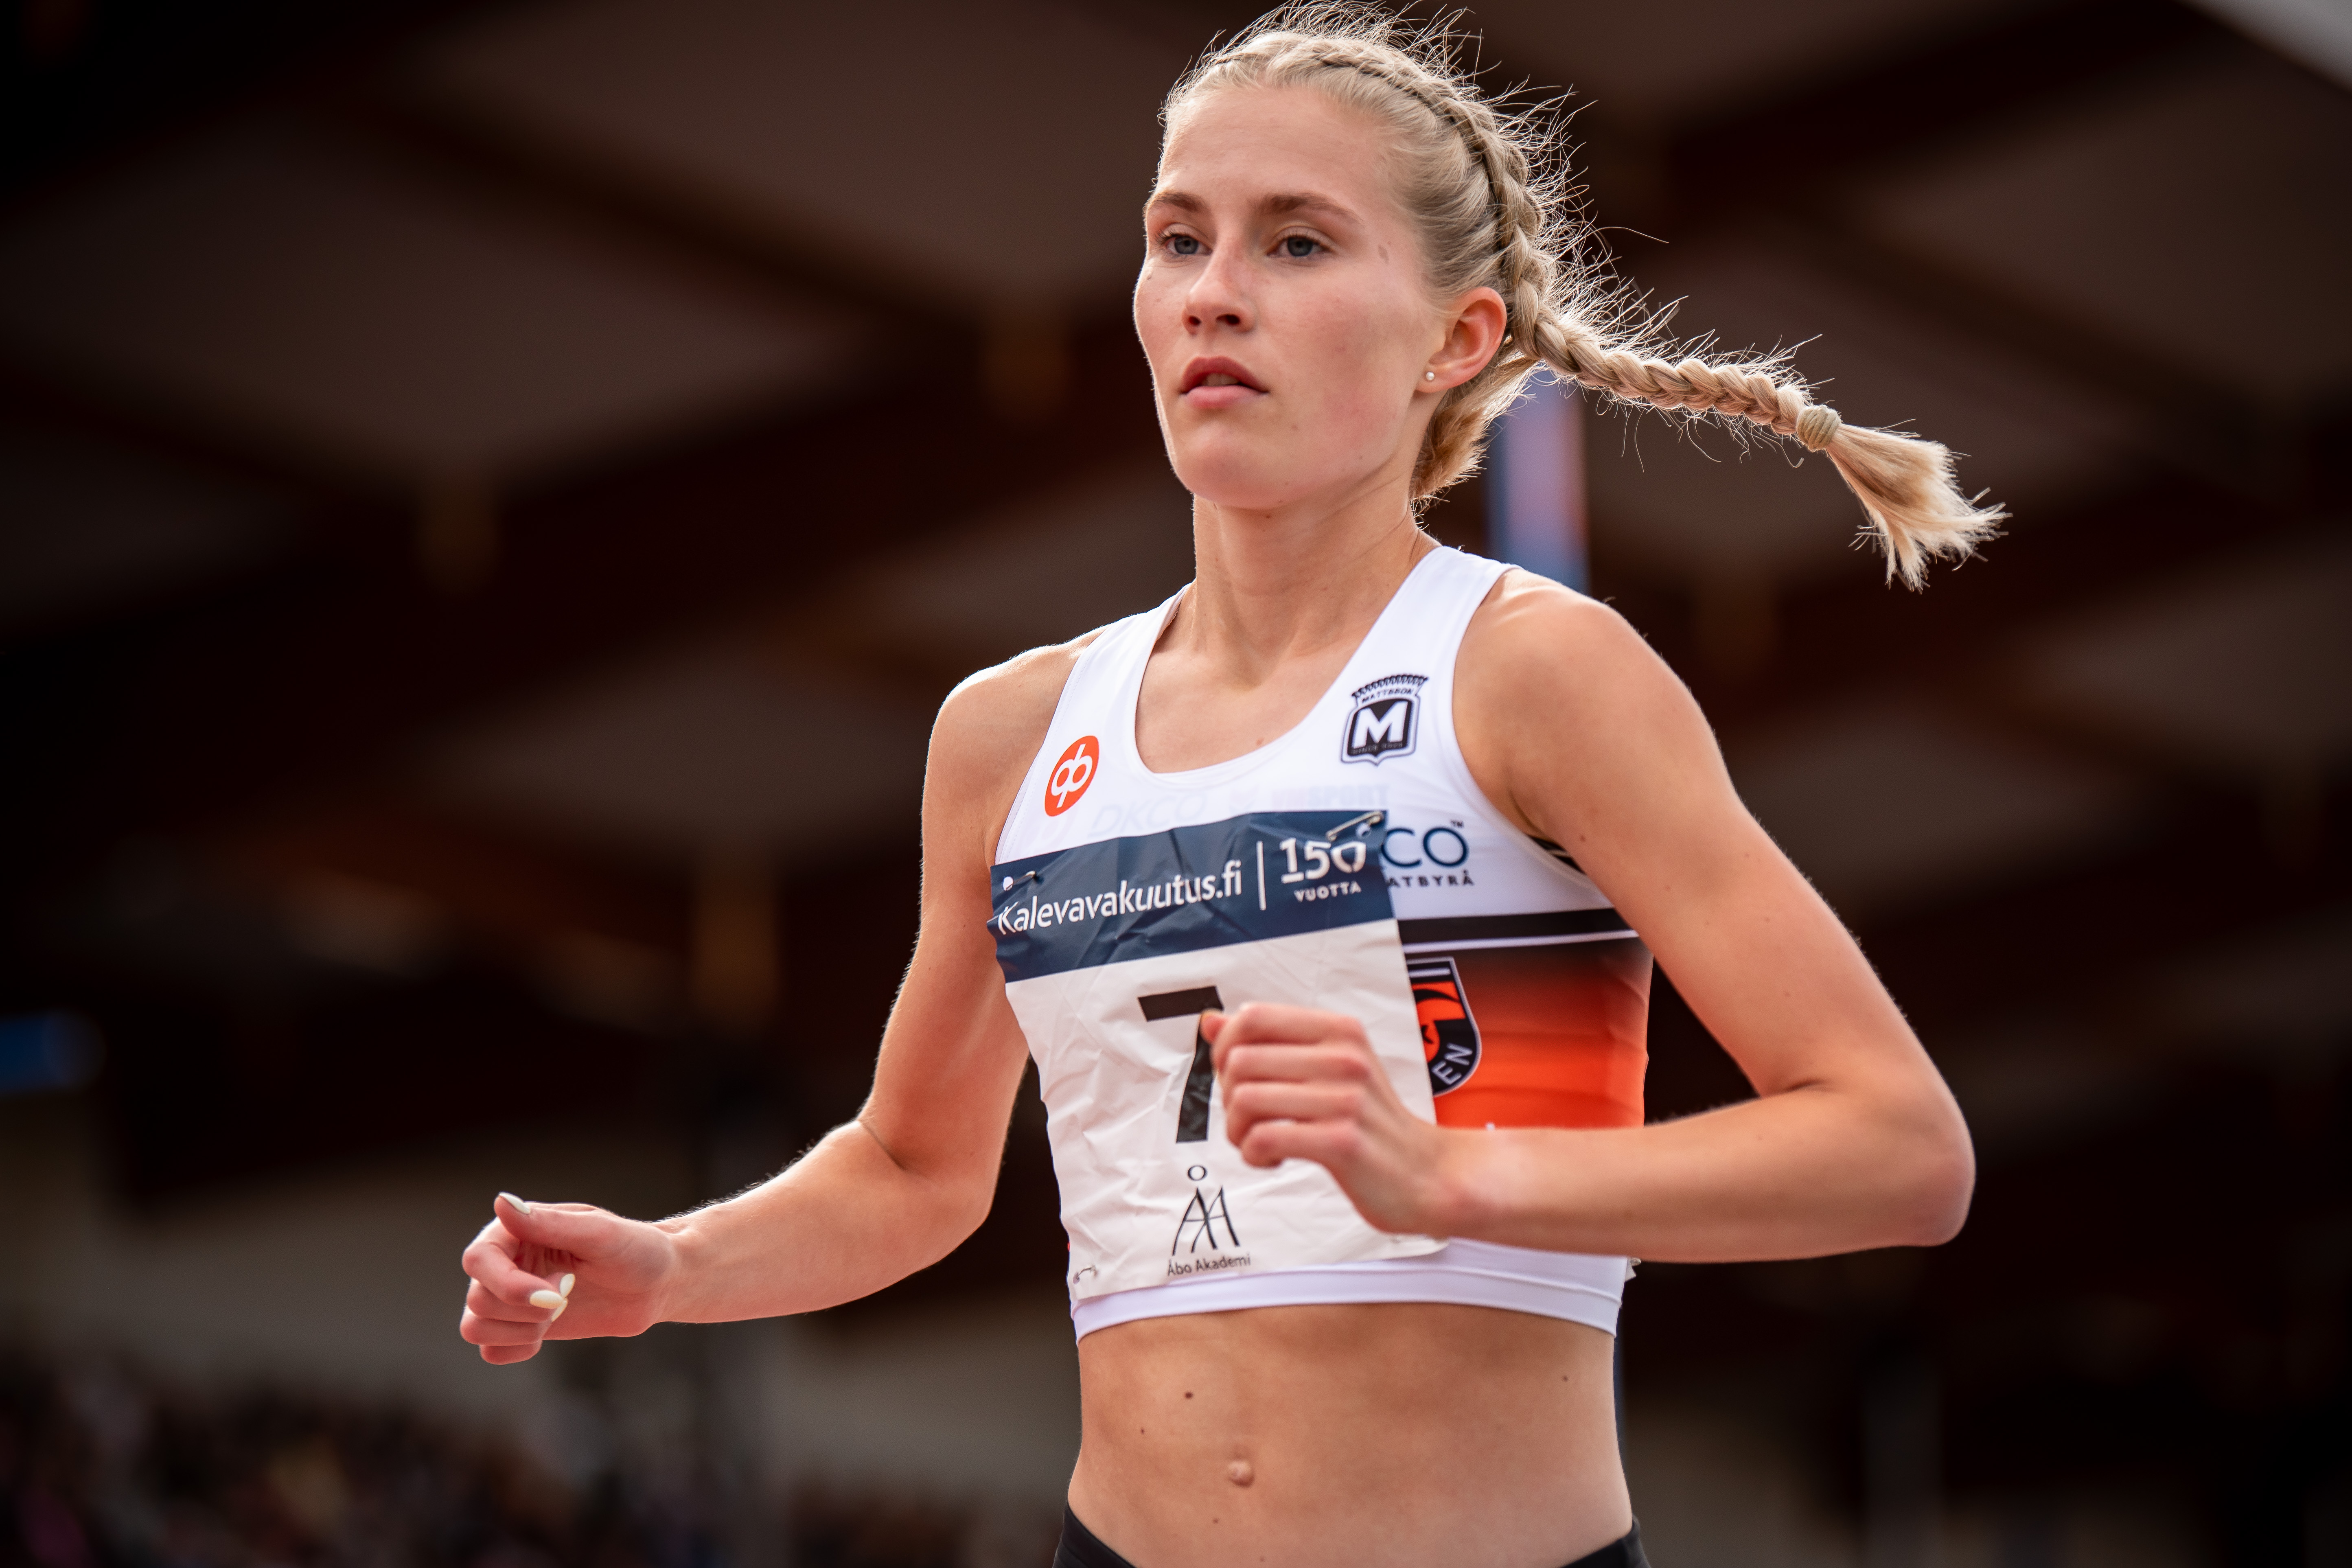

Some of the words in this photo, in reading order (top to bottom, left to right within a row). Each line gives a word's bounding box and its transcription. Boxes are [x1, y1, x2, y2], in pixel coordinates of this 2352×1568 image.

[1351, 701, 1408, 749] M
[1279, 837, 1367, 884] 150
[998, 860, 1242, 935] Kalevavakuutus.fi
[1293, 880, 1362, 902] VUOTTA
[1137, 985, 1224, 1144] 7
[1167, 1259, 1192, 1277] Åbo
[1196, 1252, 1252, 1272] Akademi
